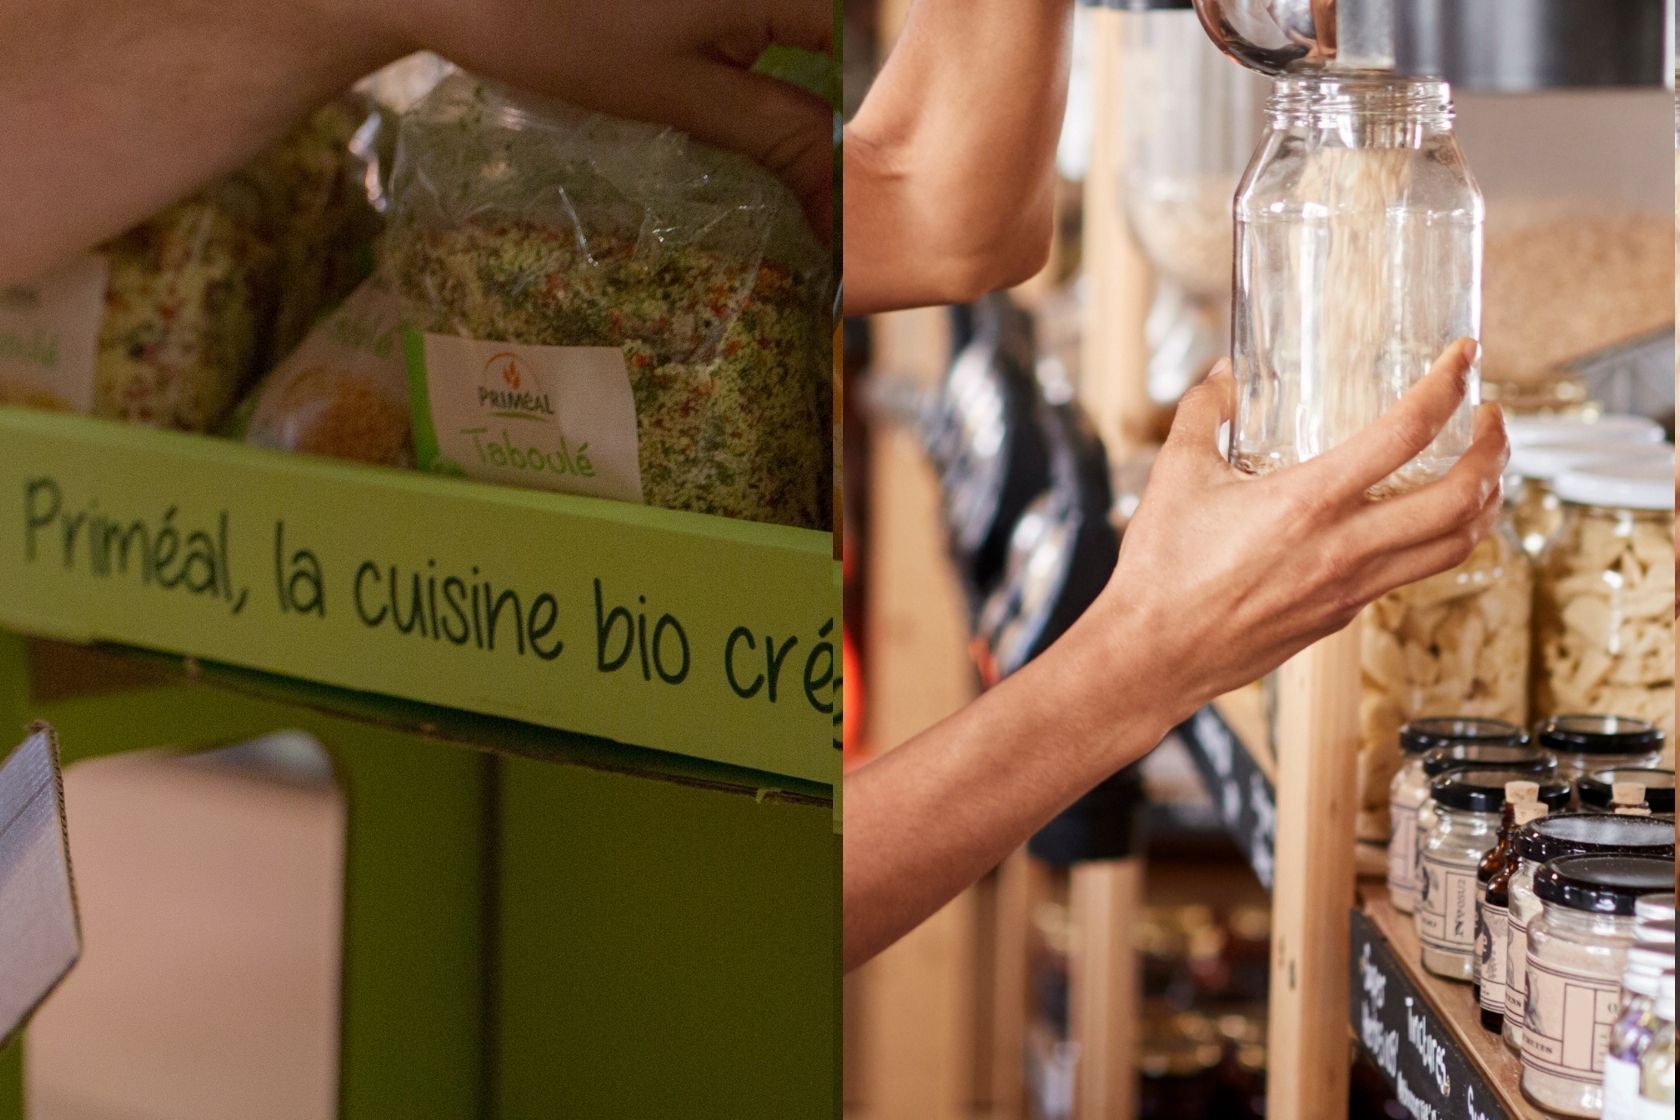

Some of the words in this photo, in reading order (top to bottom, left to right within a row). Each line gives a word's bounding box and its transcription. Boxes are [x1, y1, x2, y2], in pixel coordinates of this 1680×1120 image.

[460, 427, 597, 478] Taboulé
[25, 477, 249, 616] Priméal,
[275, 521, 326, 617] la
[353, 559, 564, 662] cuisine
[594, 577, 691, 686] bio
[724, 617, 834, 714] cré
